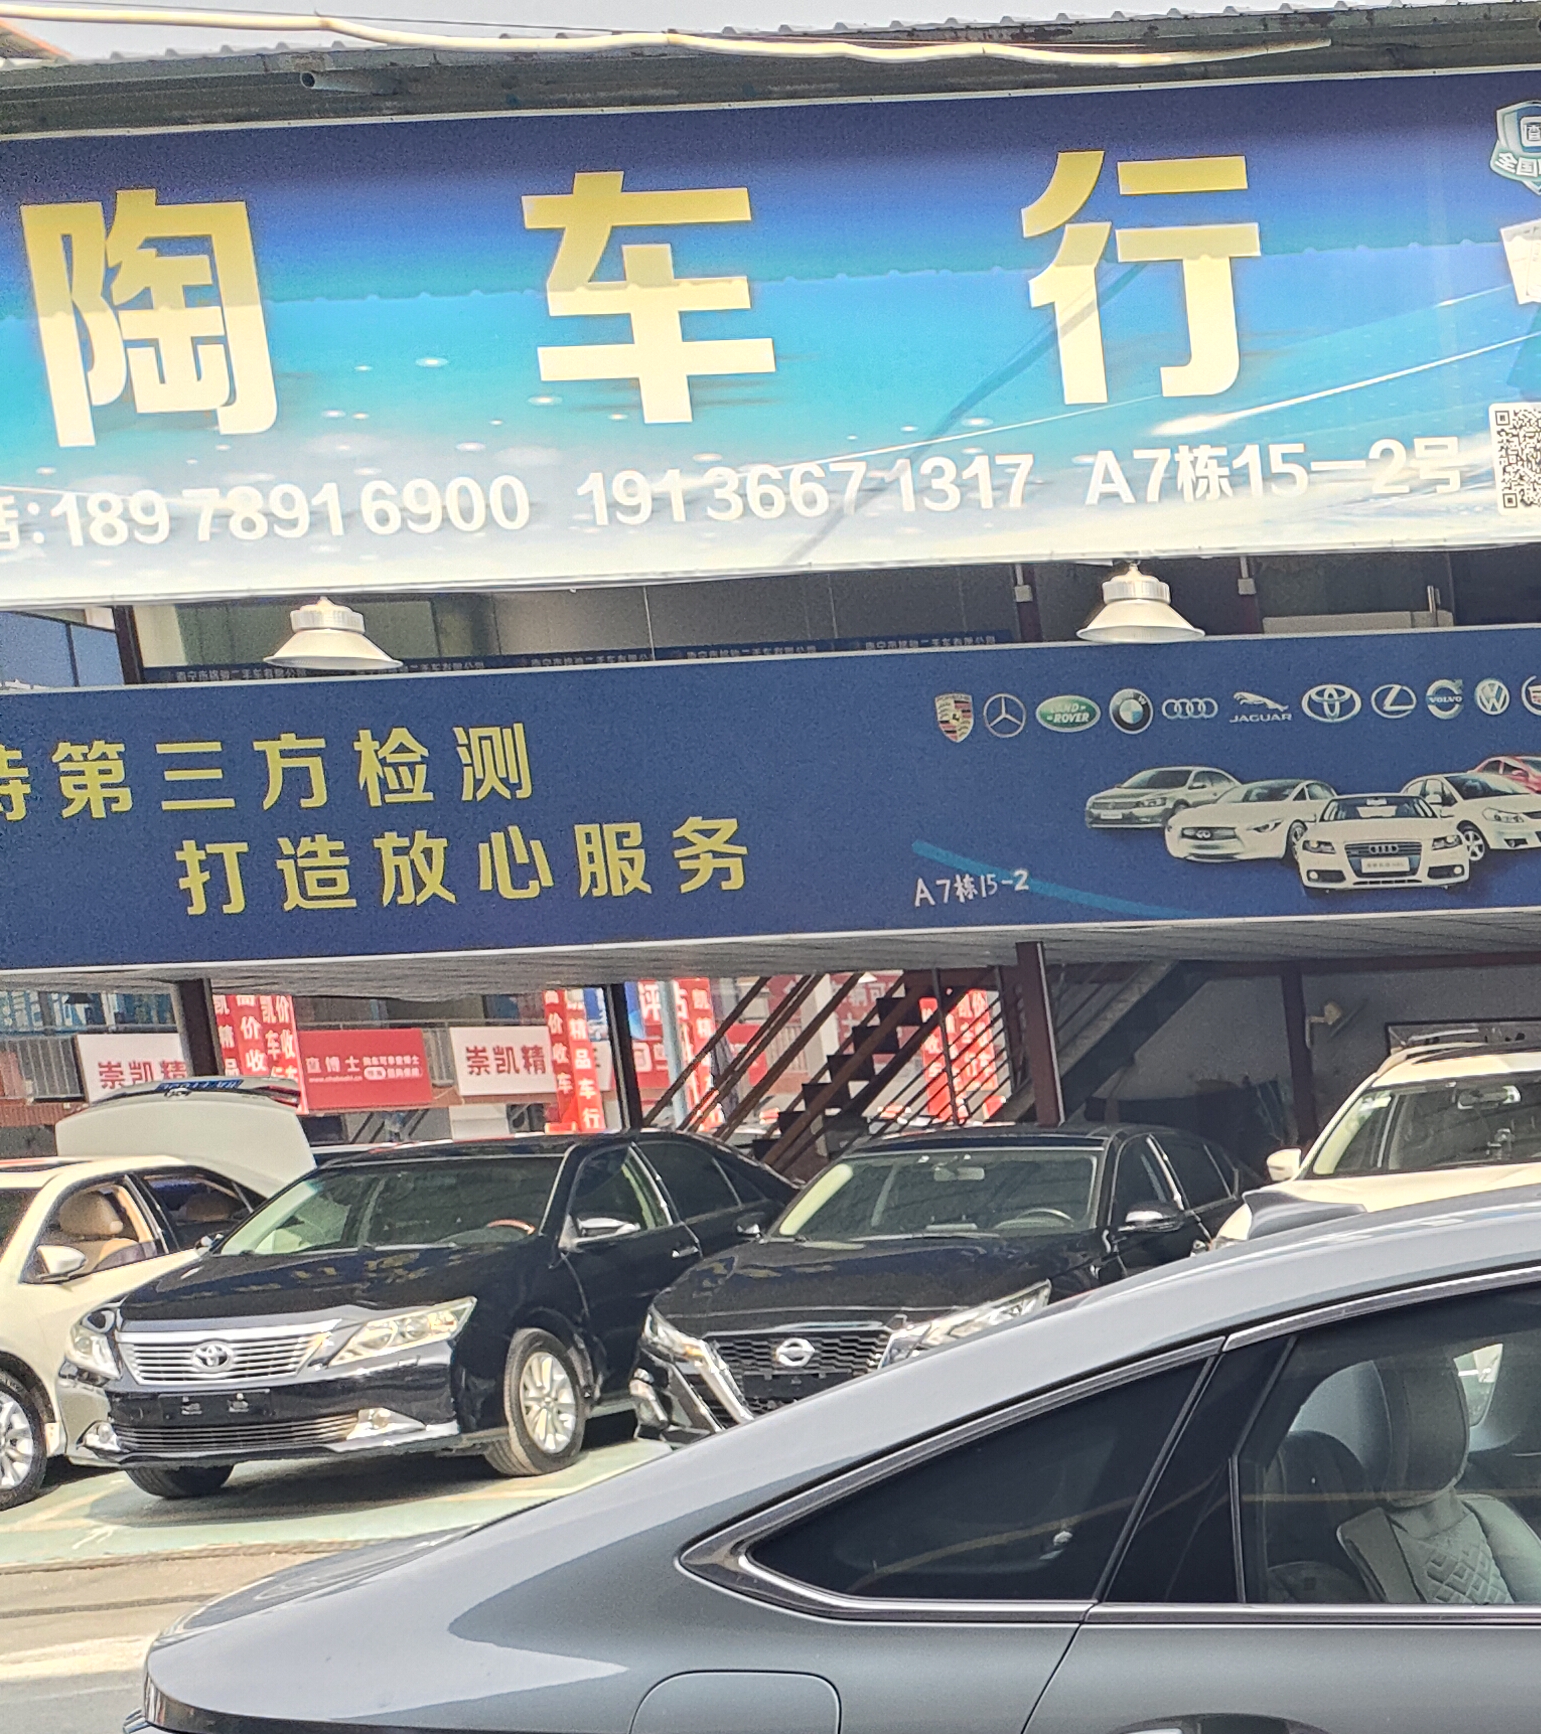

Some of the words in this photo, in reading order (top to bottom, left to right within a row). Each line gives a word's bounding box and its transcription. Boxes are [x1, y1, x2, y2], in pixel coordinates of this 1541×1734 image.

[20, 150, 1261, 448] 陶车行
[1429, 695, 1462, 705] VOLVO
[1053, 712, 1090, 723] ROVER
[1229, 713, 1293, 723] JAGUAR
[175, 816, 750, 916] 打造放心服务
[914, 869, 1030, 908] A7栋15-2
